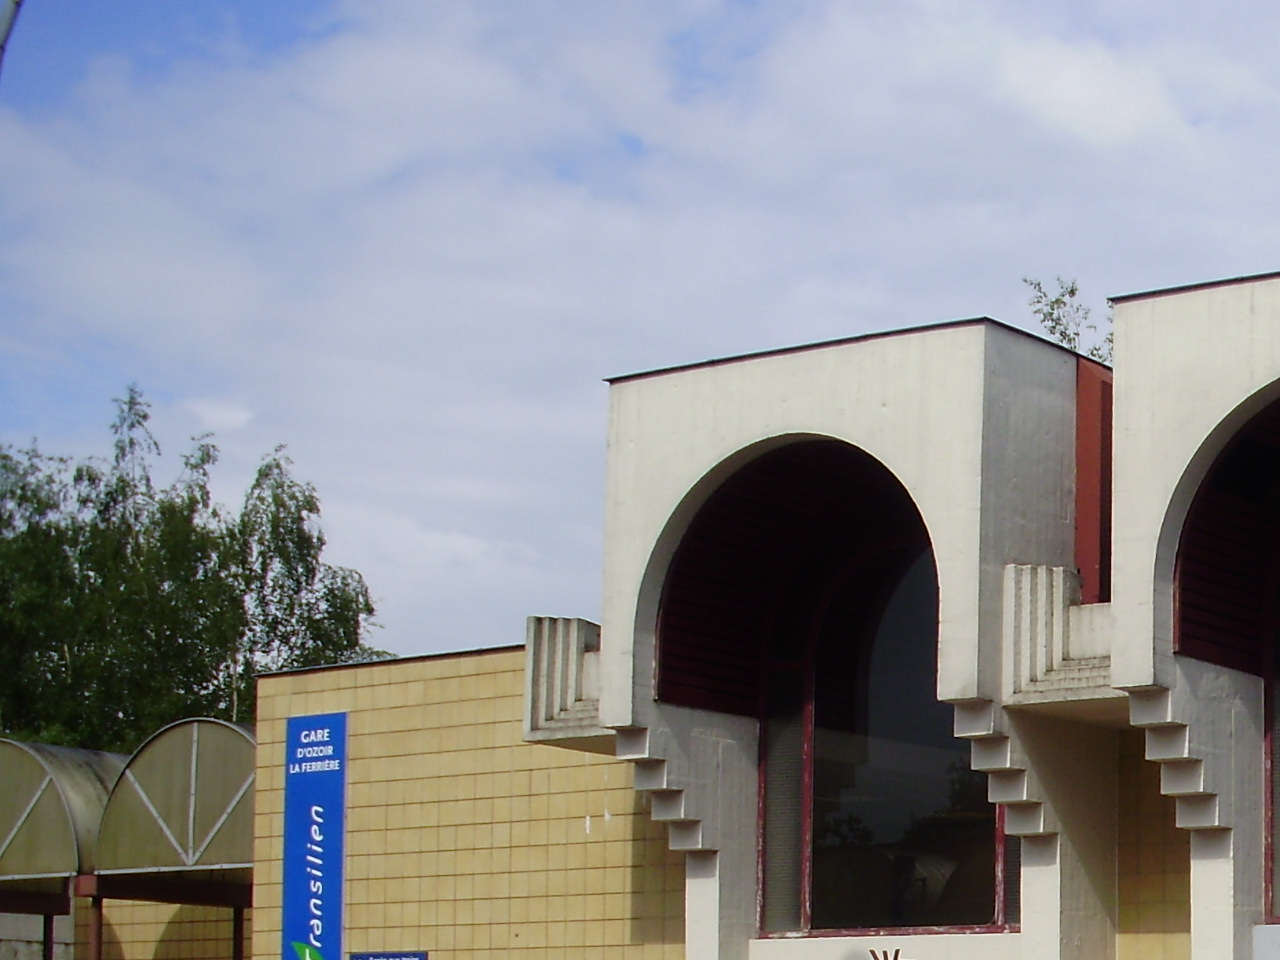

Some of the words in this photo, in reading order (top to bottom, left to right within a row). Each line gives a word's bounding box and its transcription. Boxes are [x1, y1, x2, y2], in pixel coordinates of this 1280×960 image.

[301, 729, 330, 743] GARE
[297, 745, 334, 758] D'OZOIR
[290, 764, 300, 774] LA
